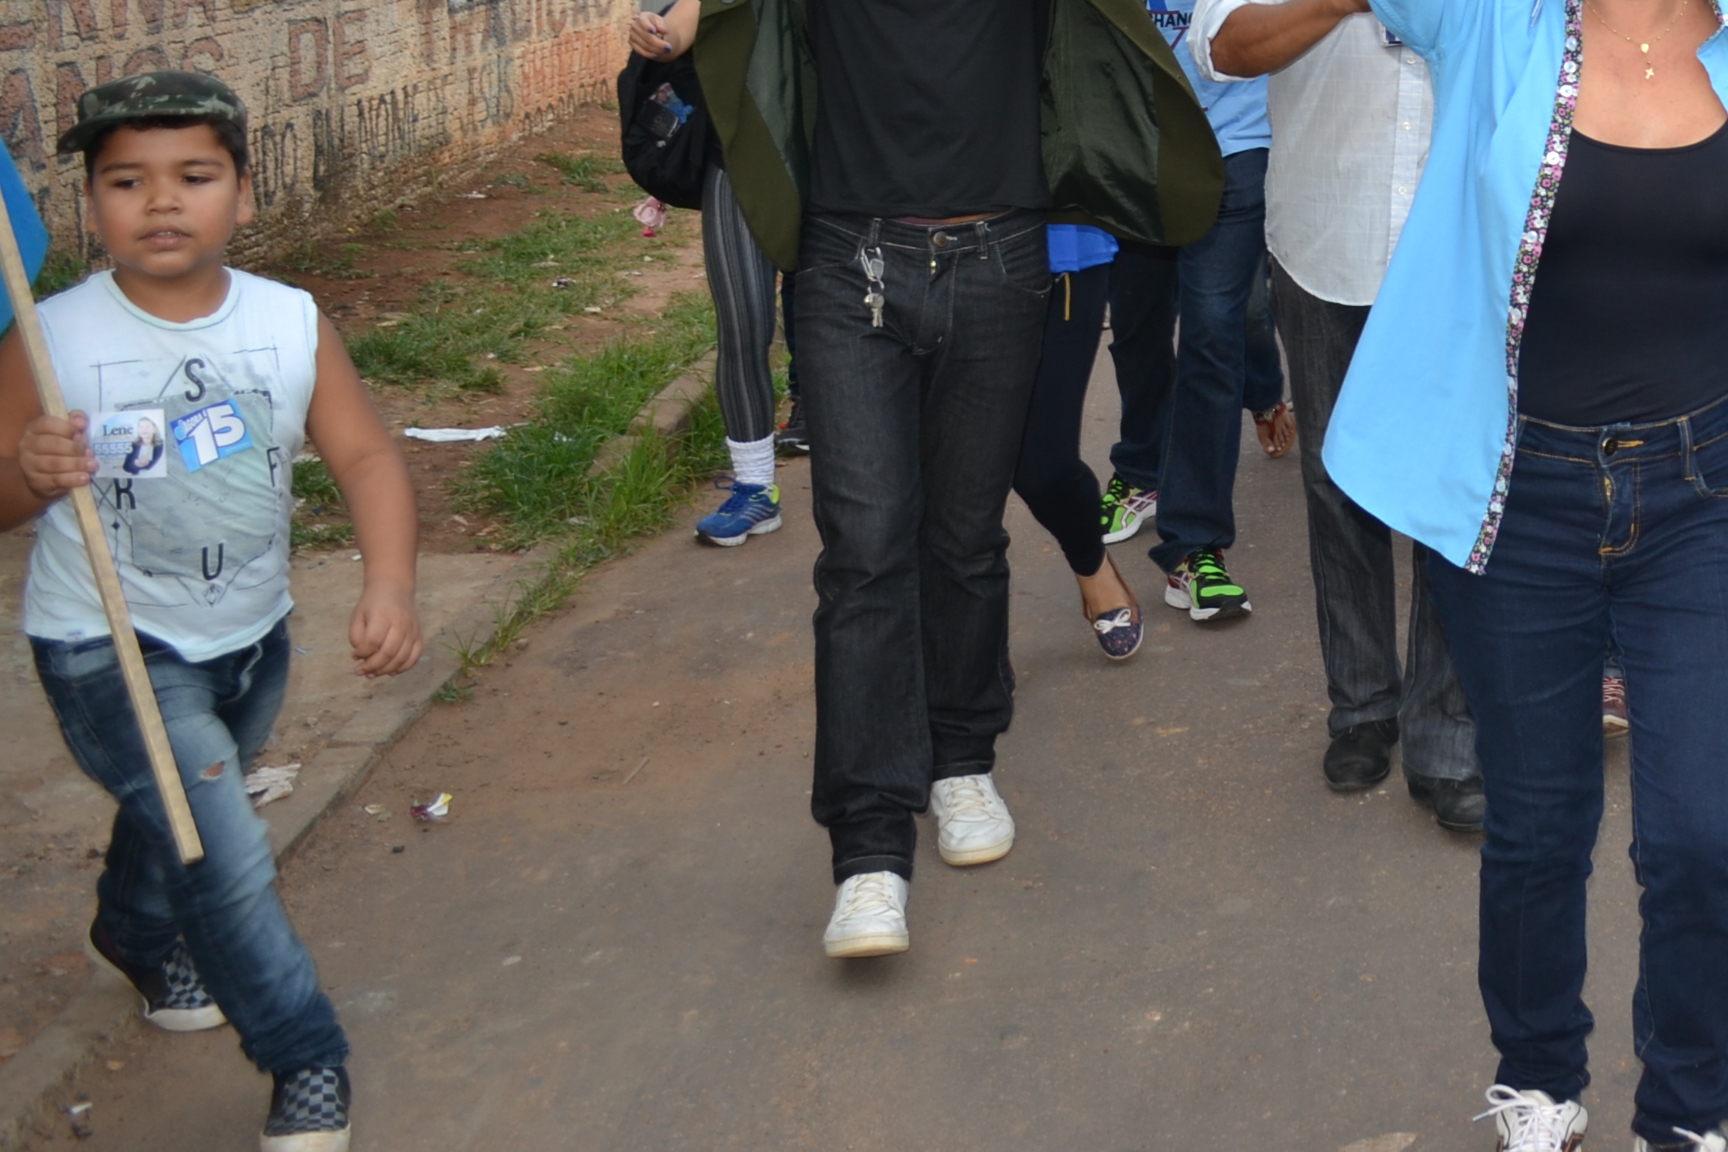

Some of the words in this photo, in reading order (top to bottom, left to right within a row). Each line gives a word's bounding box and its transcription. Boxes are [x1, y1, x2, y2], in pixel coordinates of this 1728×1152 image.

[184, 357, 206, 403] S
[103, 424, 134, 436] Lene
[188, 403, 246, 466] 15
[202, 542, 224, 582] U
